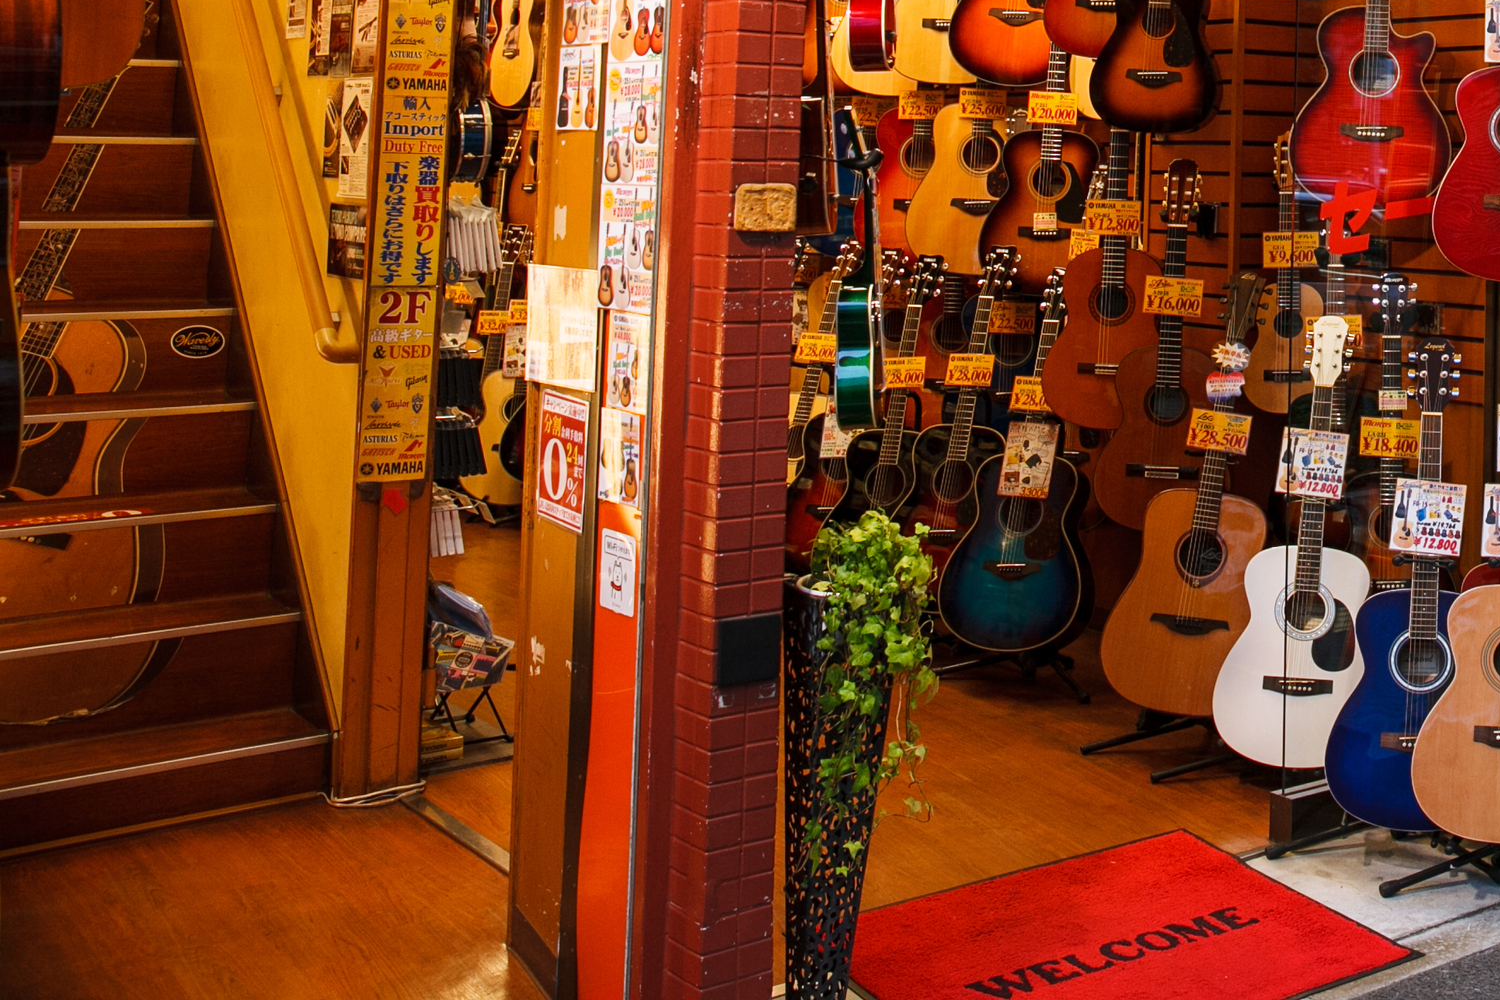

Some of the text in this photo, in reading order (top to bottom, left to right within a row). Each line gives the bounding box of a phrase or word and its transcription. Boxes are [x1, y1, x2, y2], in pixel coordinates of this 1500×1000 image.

[409, 16, 433, 27] Taylor
[388, 49, 423, 60] ASTURIAS
[402, 77, 448, 92] YAMAHA
[402, 95, 432, 112] 輸入
[960, 102, 1006, 116] ¥25,600
[385, 111, 446, 122] アコースティック
[1030, 106, 1076, 121] ¥20,000
[383, 120, 445, 138] Import
[384, 138, 444, 154] Duty Free
[1094, 202, 1116, 210] YAMAHA
[378, 160, 410, 285] 下取りはさらにお得です
[410, 155, 441, 285] 楽器買取りします
[1087, 217, 1140, 232] ¥12,800
[1268, 249, 1314, 265] ¥9,600
[377, 290, 433, 326] 2F
[1145, 294, 1200, 312] ¥16,000
[989, 316, 1034, 330] ¥22,500
[174, 330, 221, 349] Waverly
[370, 328, 434, 343] 高級ギター
[372, 343, 432, 360] & USED
[798, 344, 837, 359] ¥28,000
[405, 374, 429, 389] Gibson
[948, 368, 991, 383] ¥28,000
[385, 399, 410, 410] Taylor
[543, 413, 561, 438] 分割
[362, 434, 398, 444] ASTURIAS
[1190, 427, 1248, 449] ¥28,500
[1362, 436, 1418, 454] ¥18,400
[376, 460, 424, 476] YAMAHA
[963, 905, 1261, 1000] WELCOME
